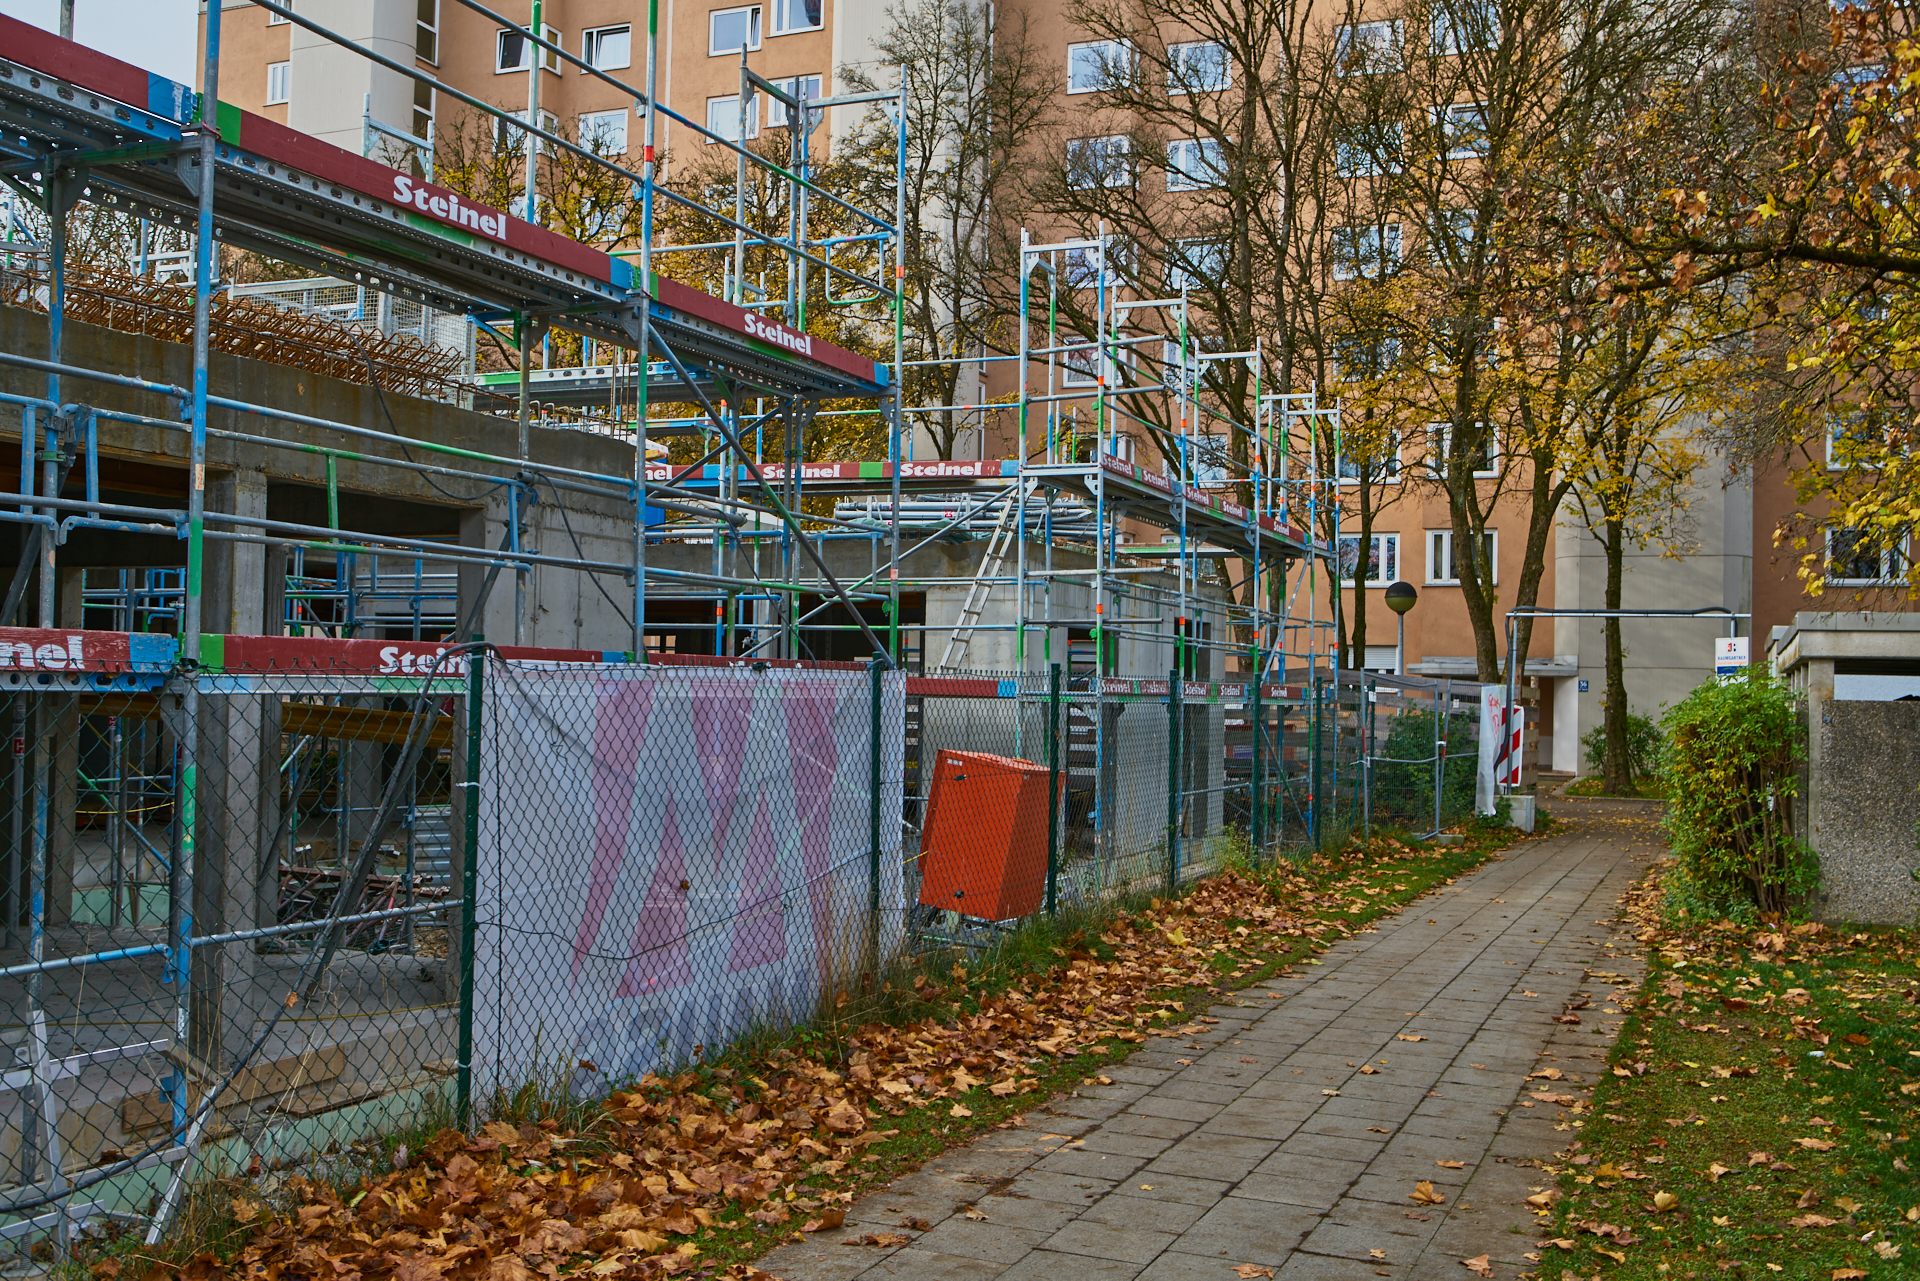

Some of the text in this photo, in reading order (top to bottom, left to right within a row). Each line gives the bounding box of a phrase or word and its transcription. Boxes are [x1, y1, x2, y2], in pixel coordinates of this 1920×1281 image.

[393, 175, 507, 240] Steinel
[744, 313, 812, 356] Steinel
[645, 465, 673, 480] nel
[900, 462, 982, 477] Steinel
[1103, 454, 1132, 475] Steinel
[1143, 470, 1169, 489] Steinel
[1187, 487, 1210, 505] Steinel
[1223, 501, 1243, 518] Steinel
[1273, 521, 1290, 536] Steinel
[0, 635, 85, 669] nel
[380, 646, 465, 674] Stein
